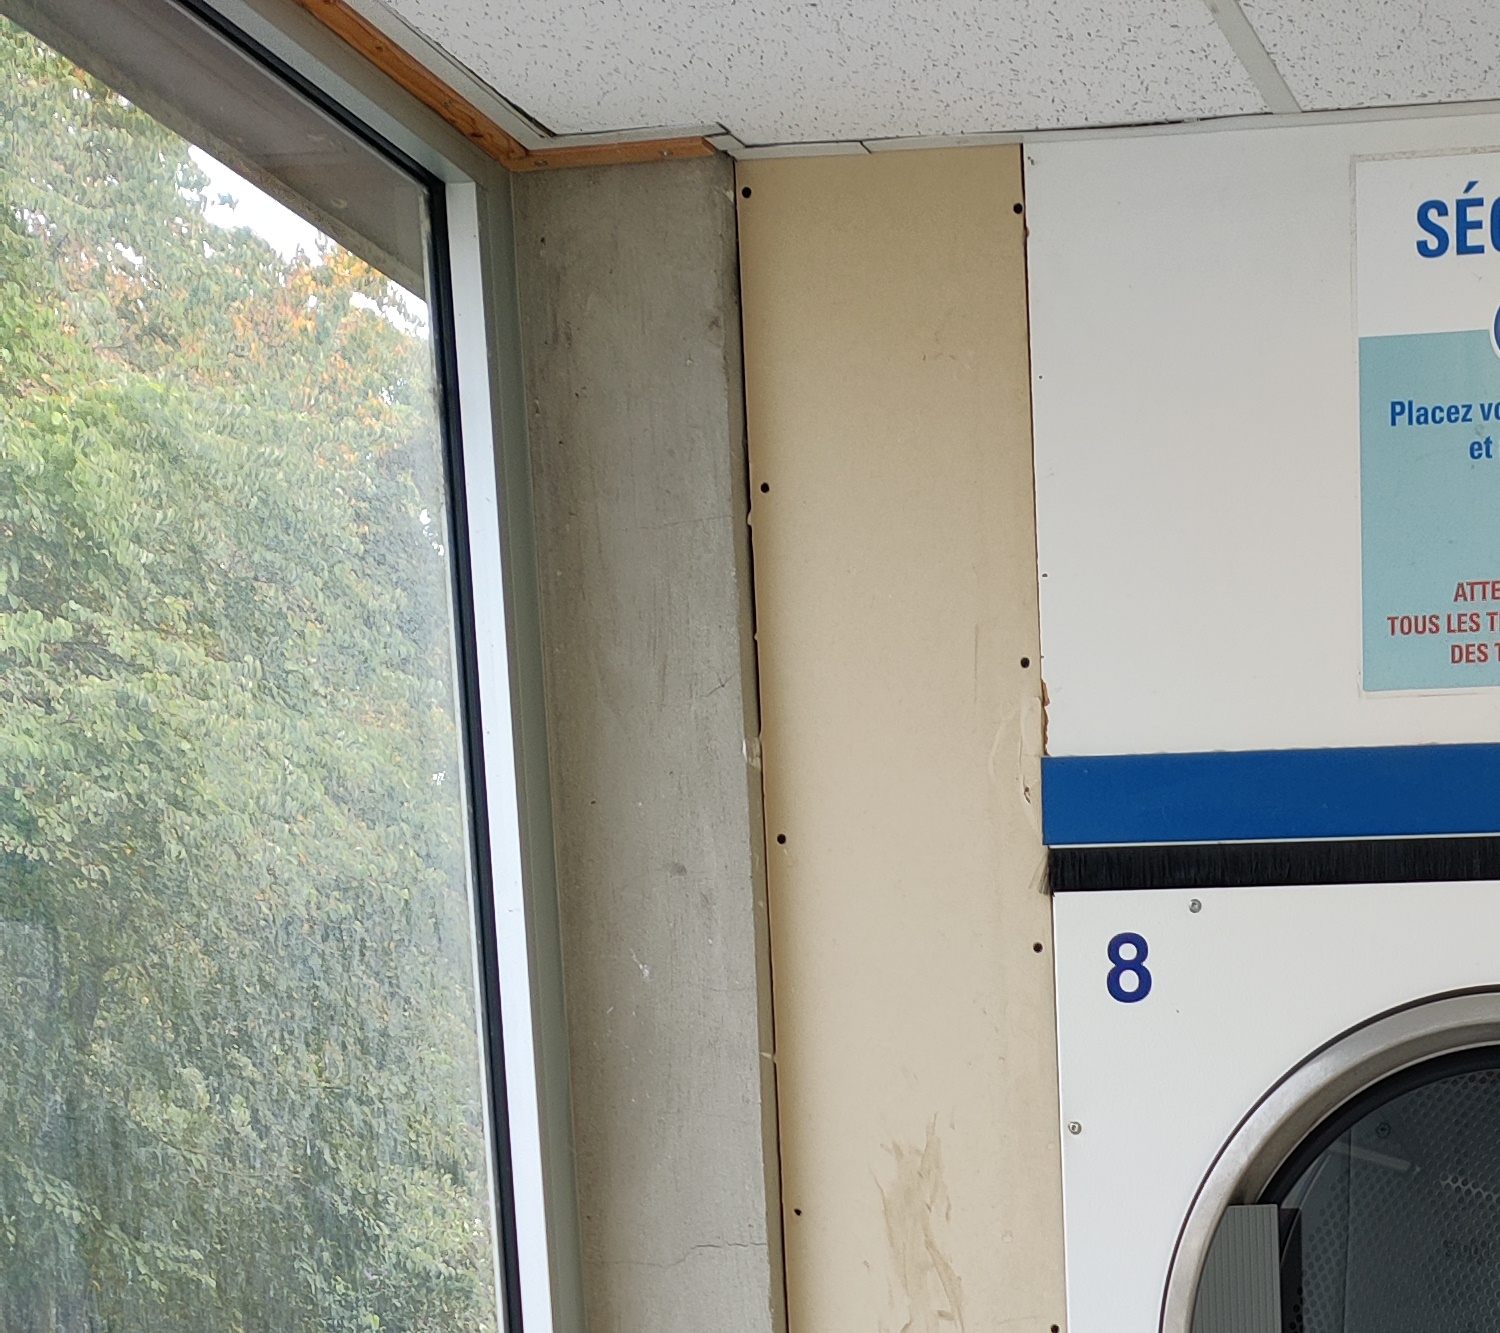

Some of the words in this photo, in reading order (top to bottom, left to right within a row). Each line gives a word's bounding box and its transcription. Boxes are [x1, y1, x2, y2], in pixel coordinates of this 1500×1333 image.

[1390, 400, 1473, 427] Placez
[1469, 435, 1493, 459] et
[1387, 614, 1440, 636] TOUS
[1447, 611, 1480, 633] LES
[1450, 642, 1489, 664] DES
[1105, 931, 1153, 1003] 8
